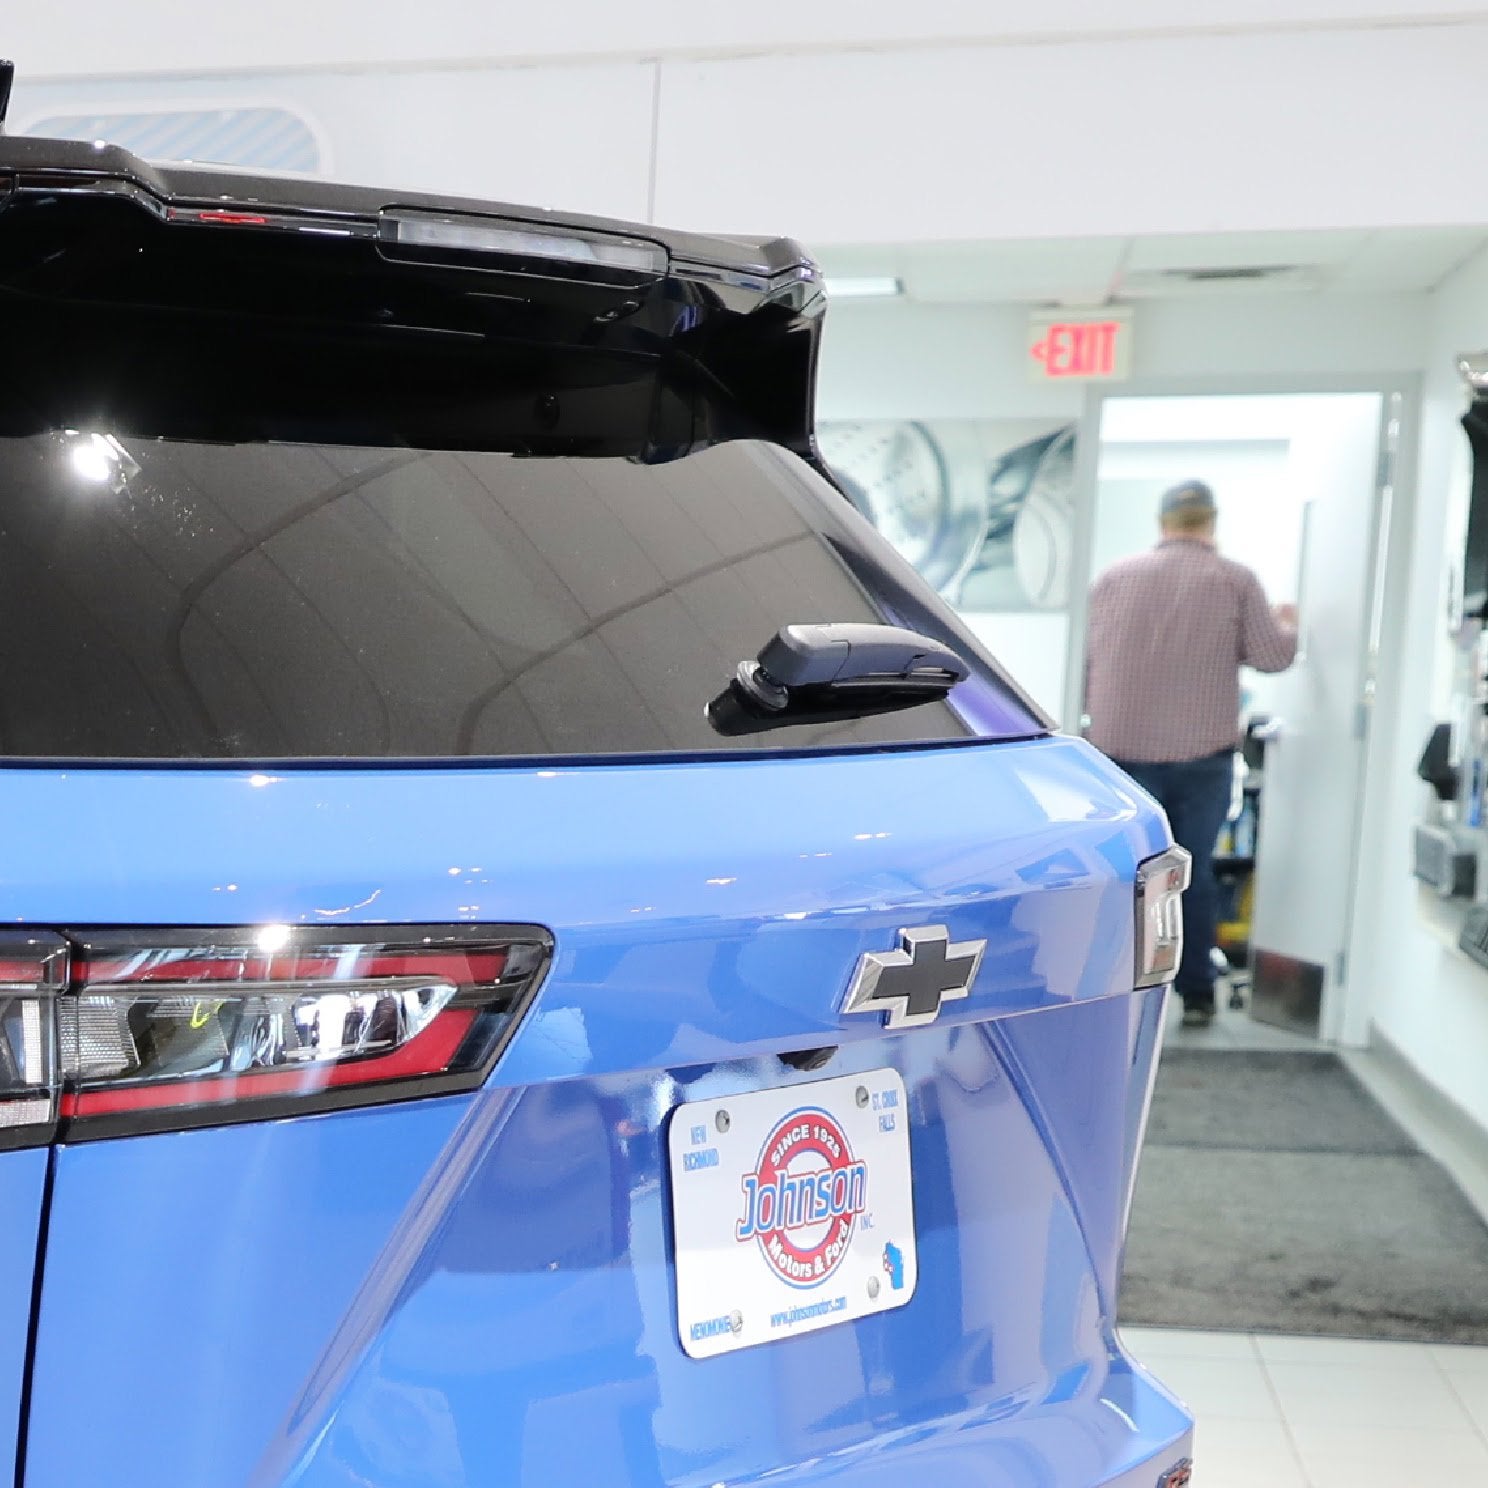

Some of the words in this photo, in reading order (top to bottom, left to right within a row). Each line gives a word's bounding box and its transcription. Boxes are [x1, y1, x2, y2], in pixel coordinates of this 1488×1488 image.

[1045, 321, 1121, 377] EXIT
[771, 1124, 809, 1165] SINCE
[737, 1160, 865, 1242] Johnson
[769, 1234, 813, 1277] Motors
